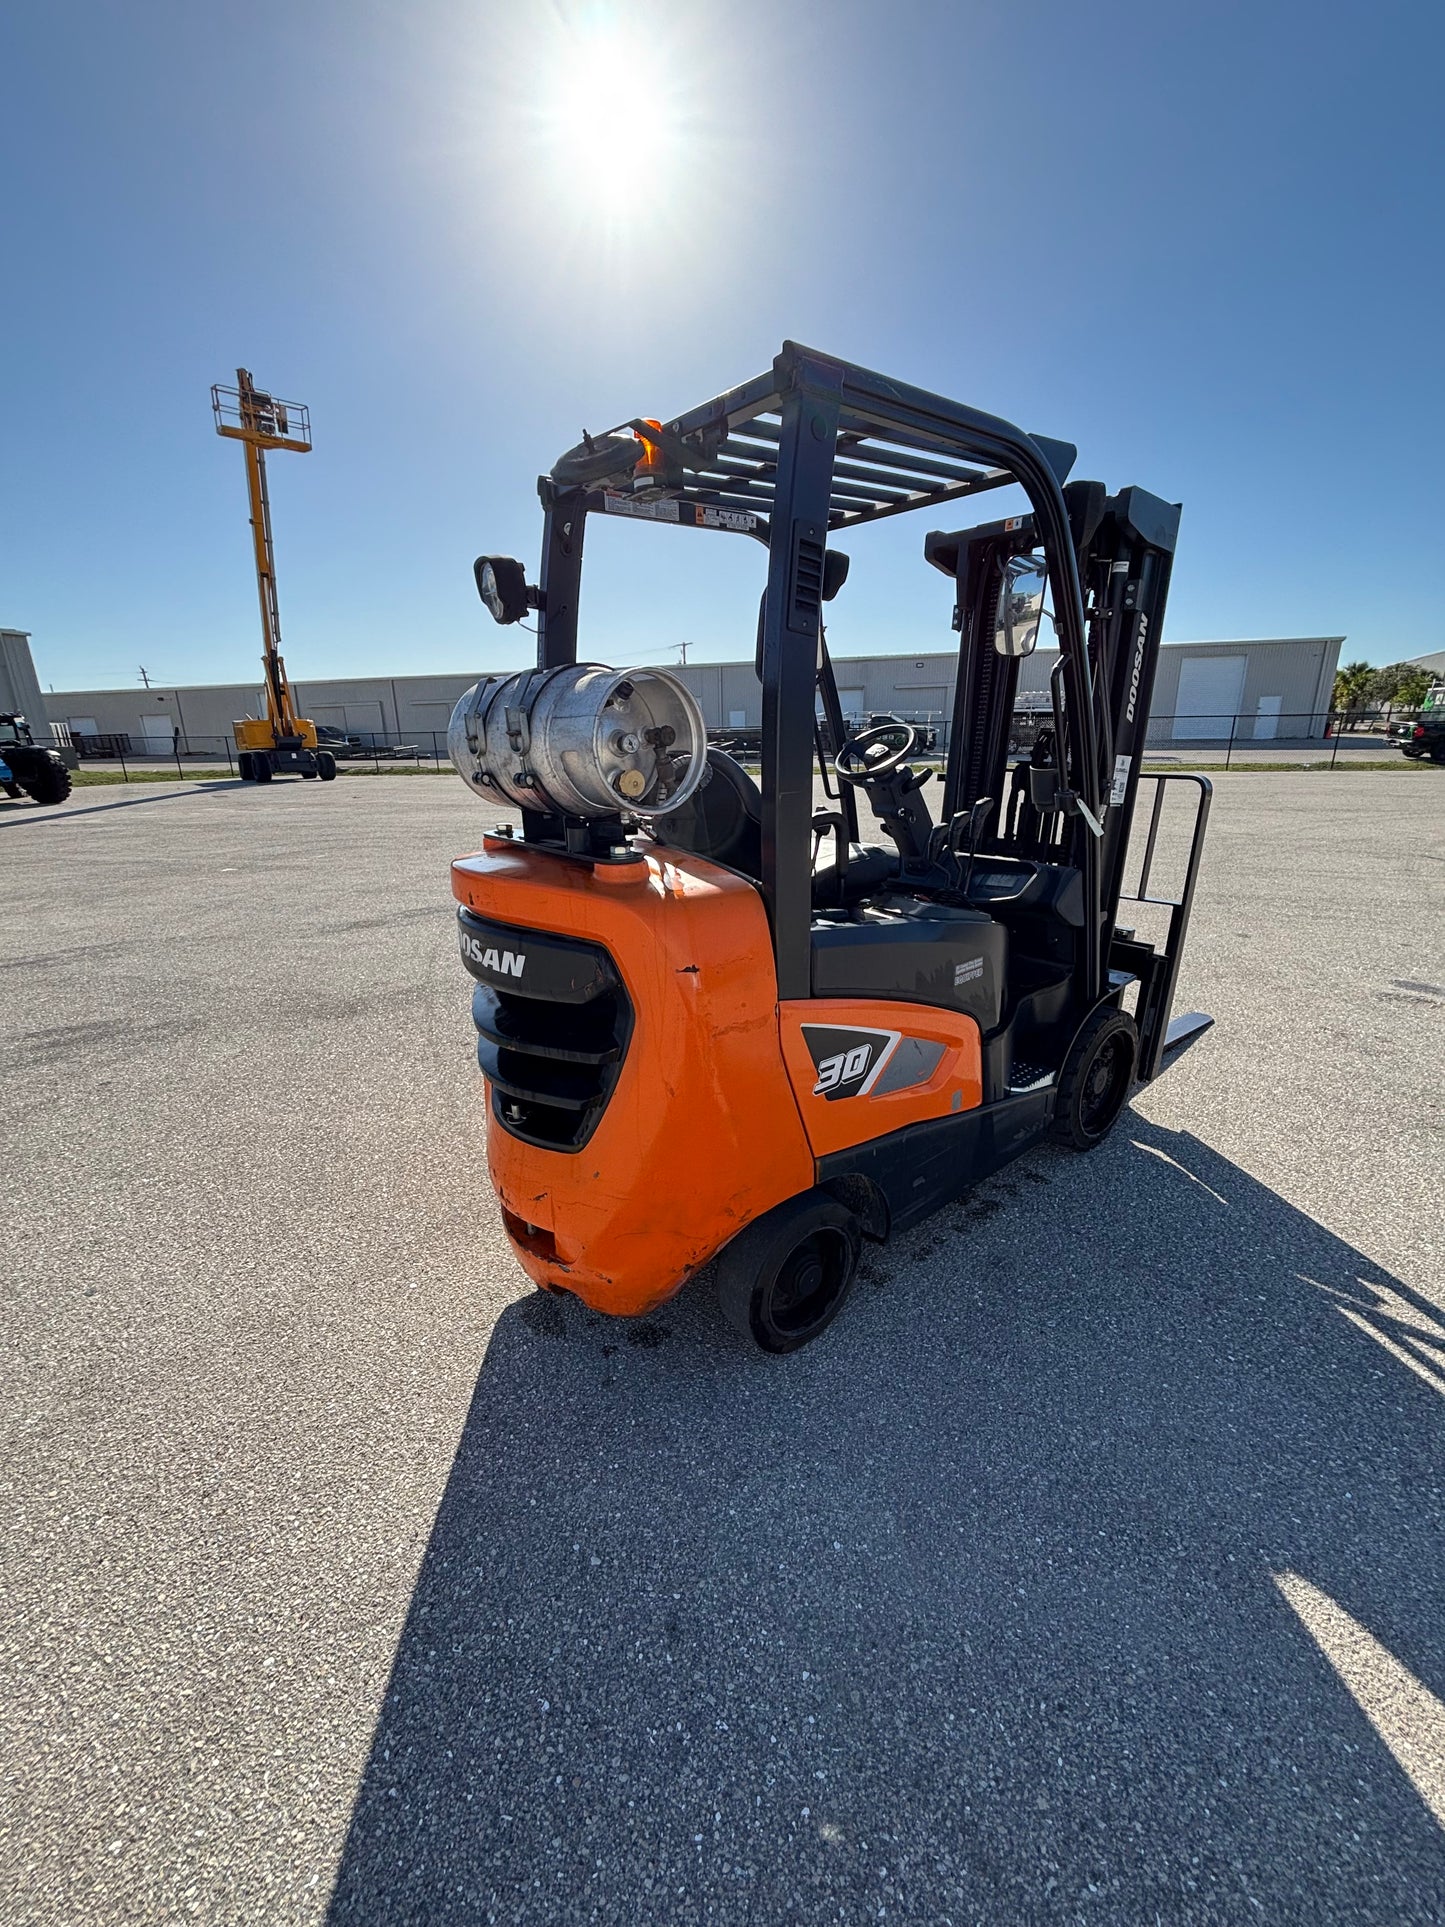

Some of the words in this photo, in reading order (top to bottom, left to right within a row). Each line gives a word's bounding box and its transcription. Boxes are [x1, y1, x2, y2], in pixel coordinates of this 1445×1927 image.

[1126, 613, 1149, 723] DOOSAN
[459, 928, 526, 978] OSAN
[814, 1044, 872, 1096] 30
